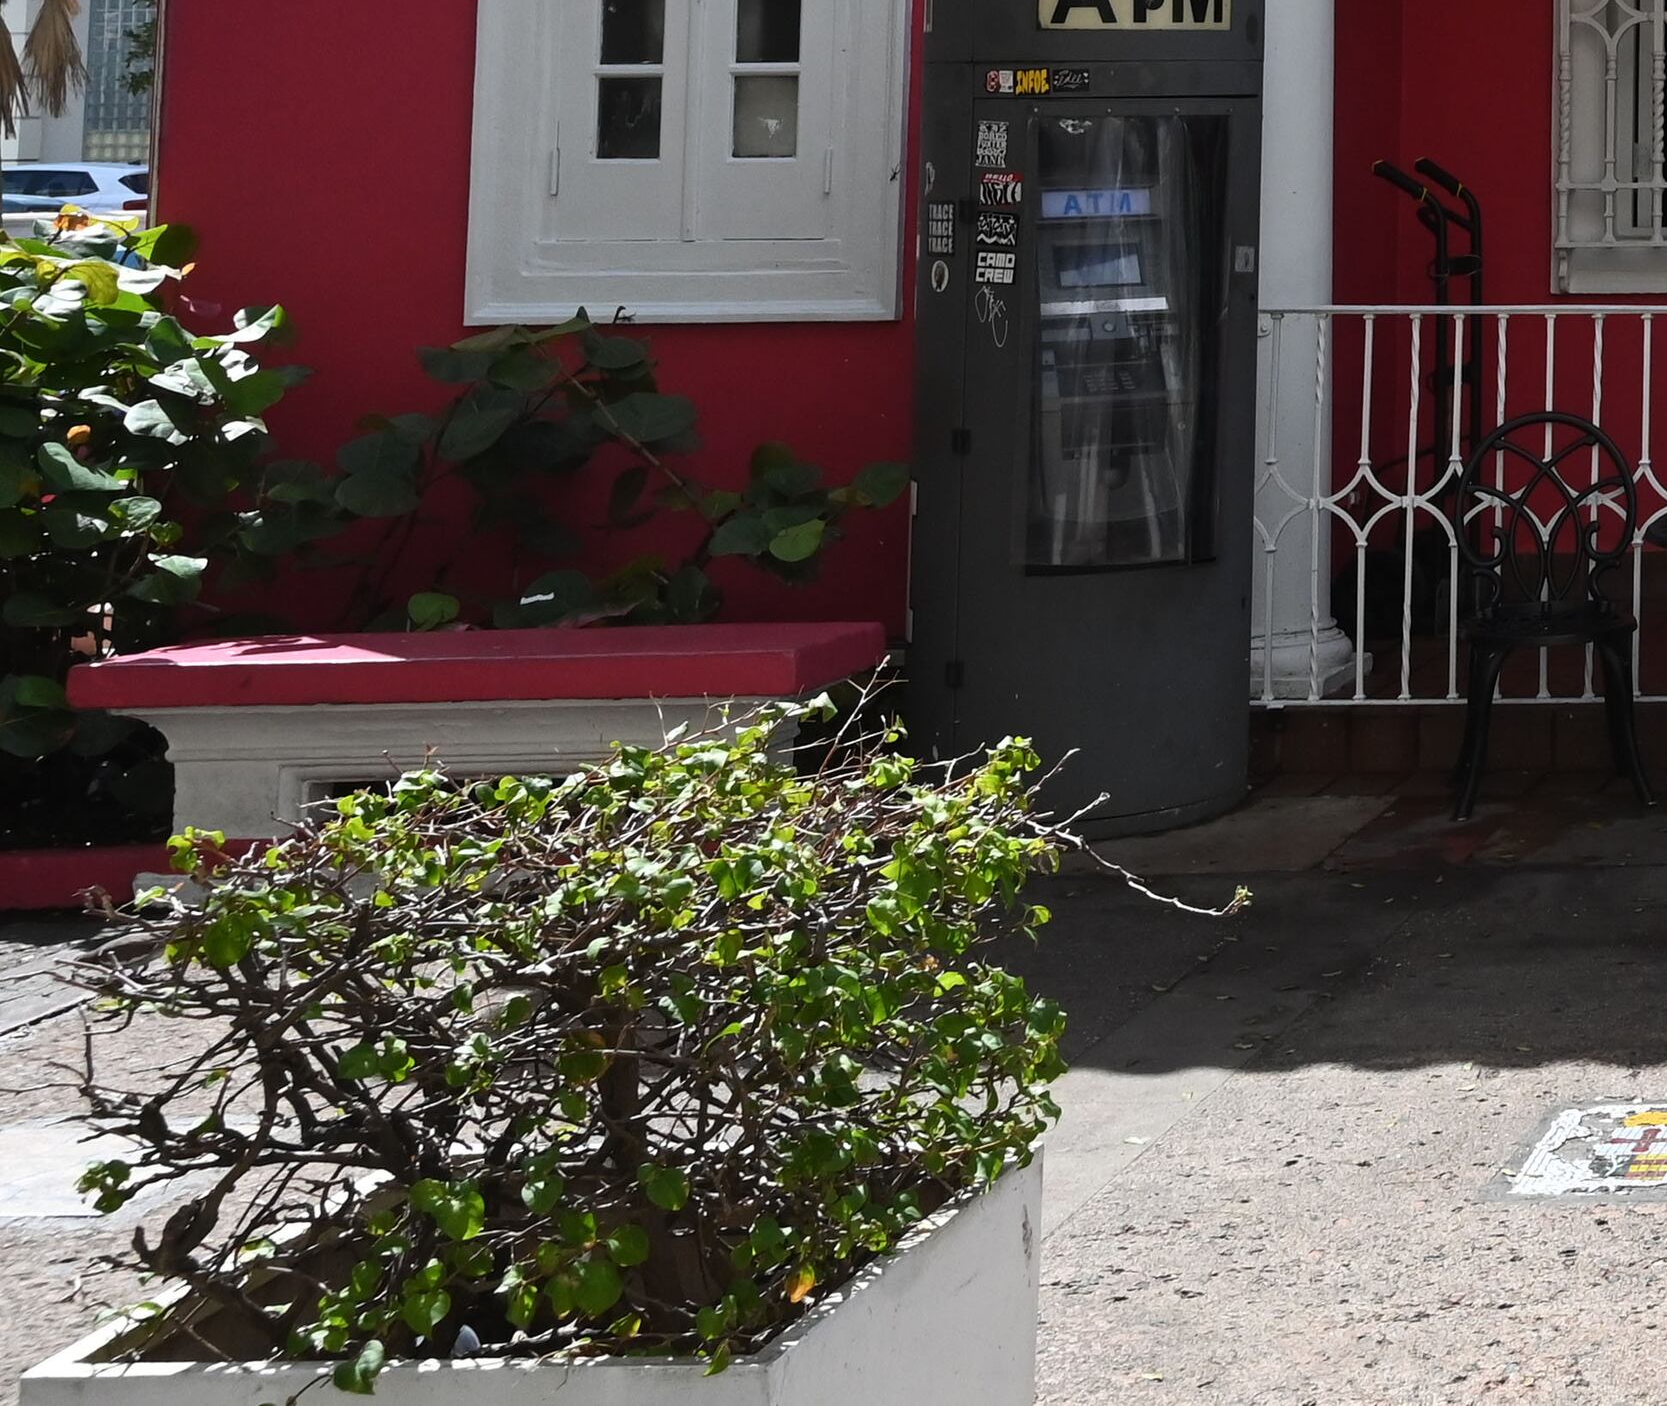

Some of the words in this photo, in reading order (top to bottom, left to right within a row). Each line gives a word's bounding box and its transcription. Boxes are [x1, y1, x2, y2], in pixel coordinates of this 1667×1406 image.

[928, 203, 954, 220] TRACE
[1063, 192, 1132, 215] ATM
[928, 220, 954, 236] TRACE
[928, 236, 954, 253] TRACE
[977, 251, 1016, 268] CAMO
[975, 267, 1014, 284] CREW
